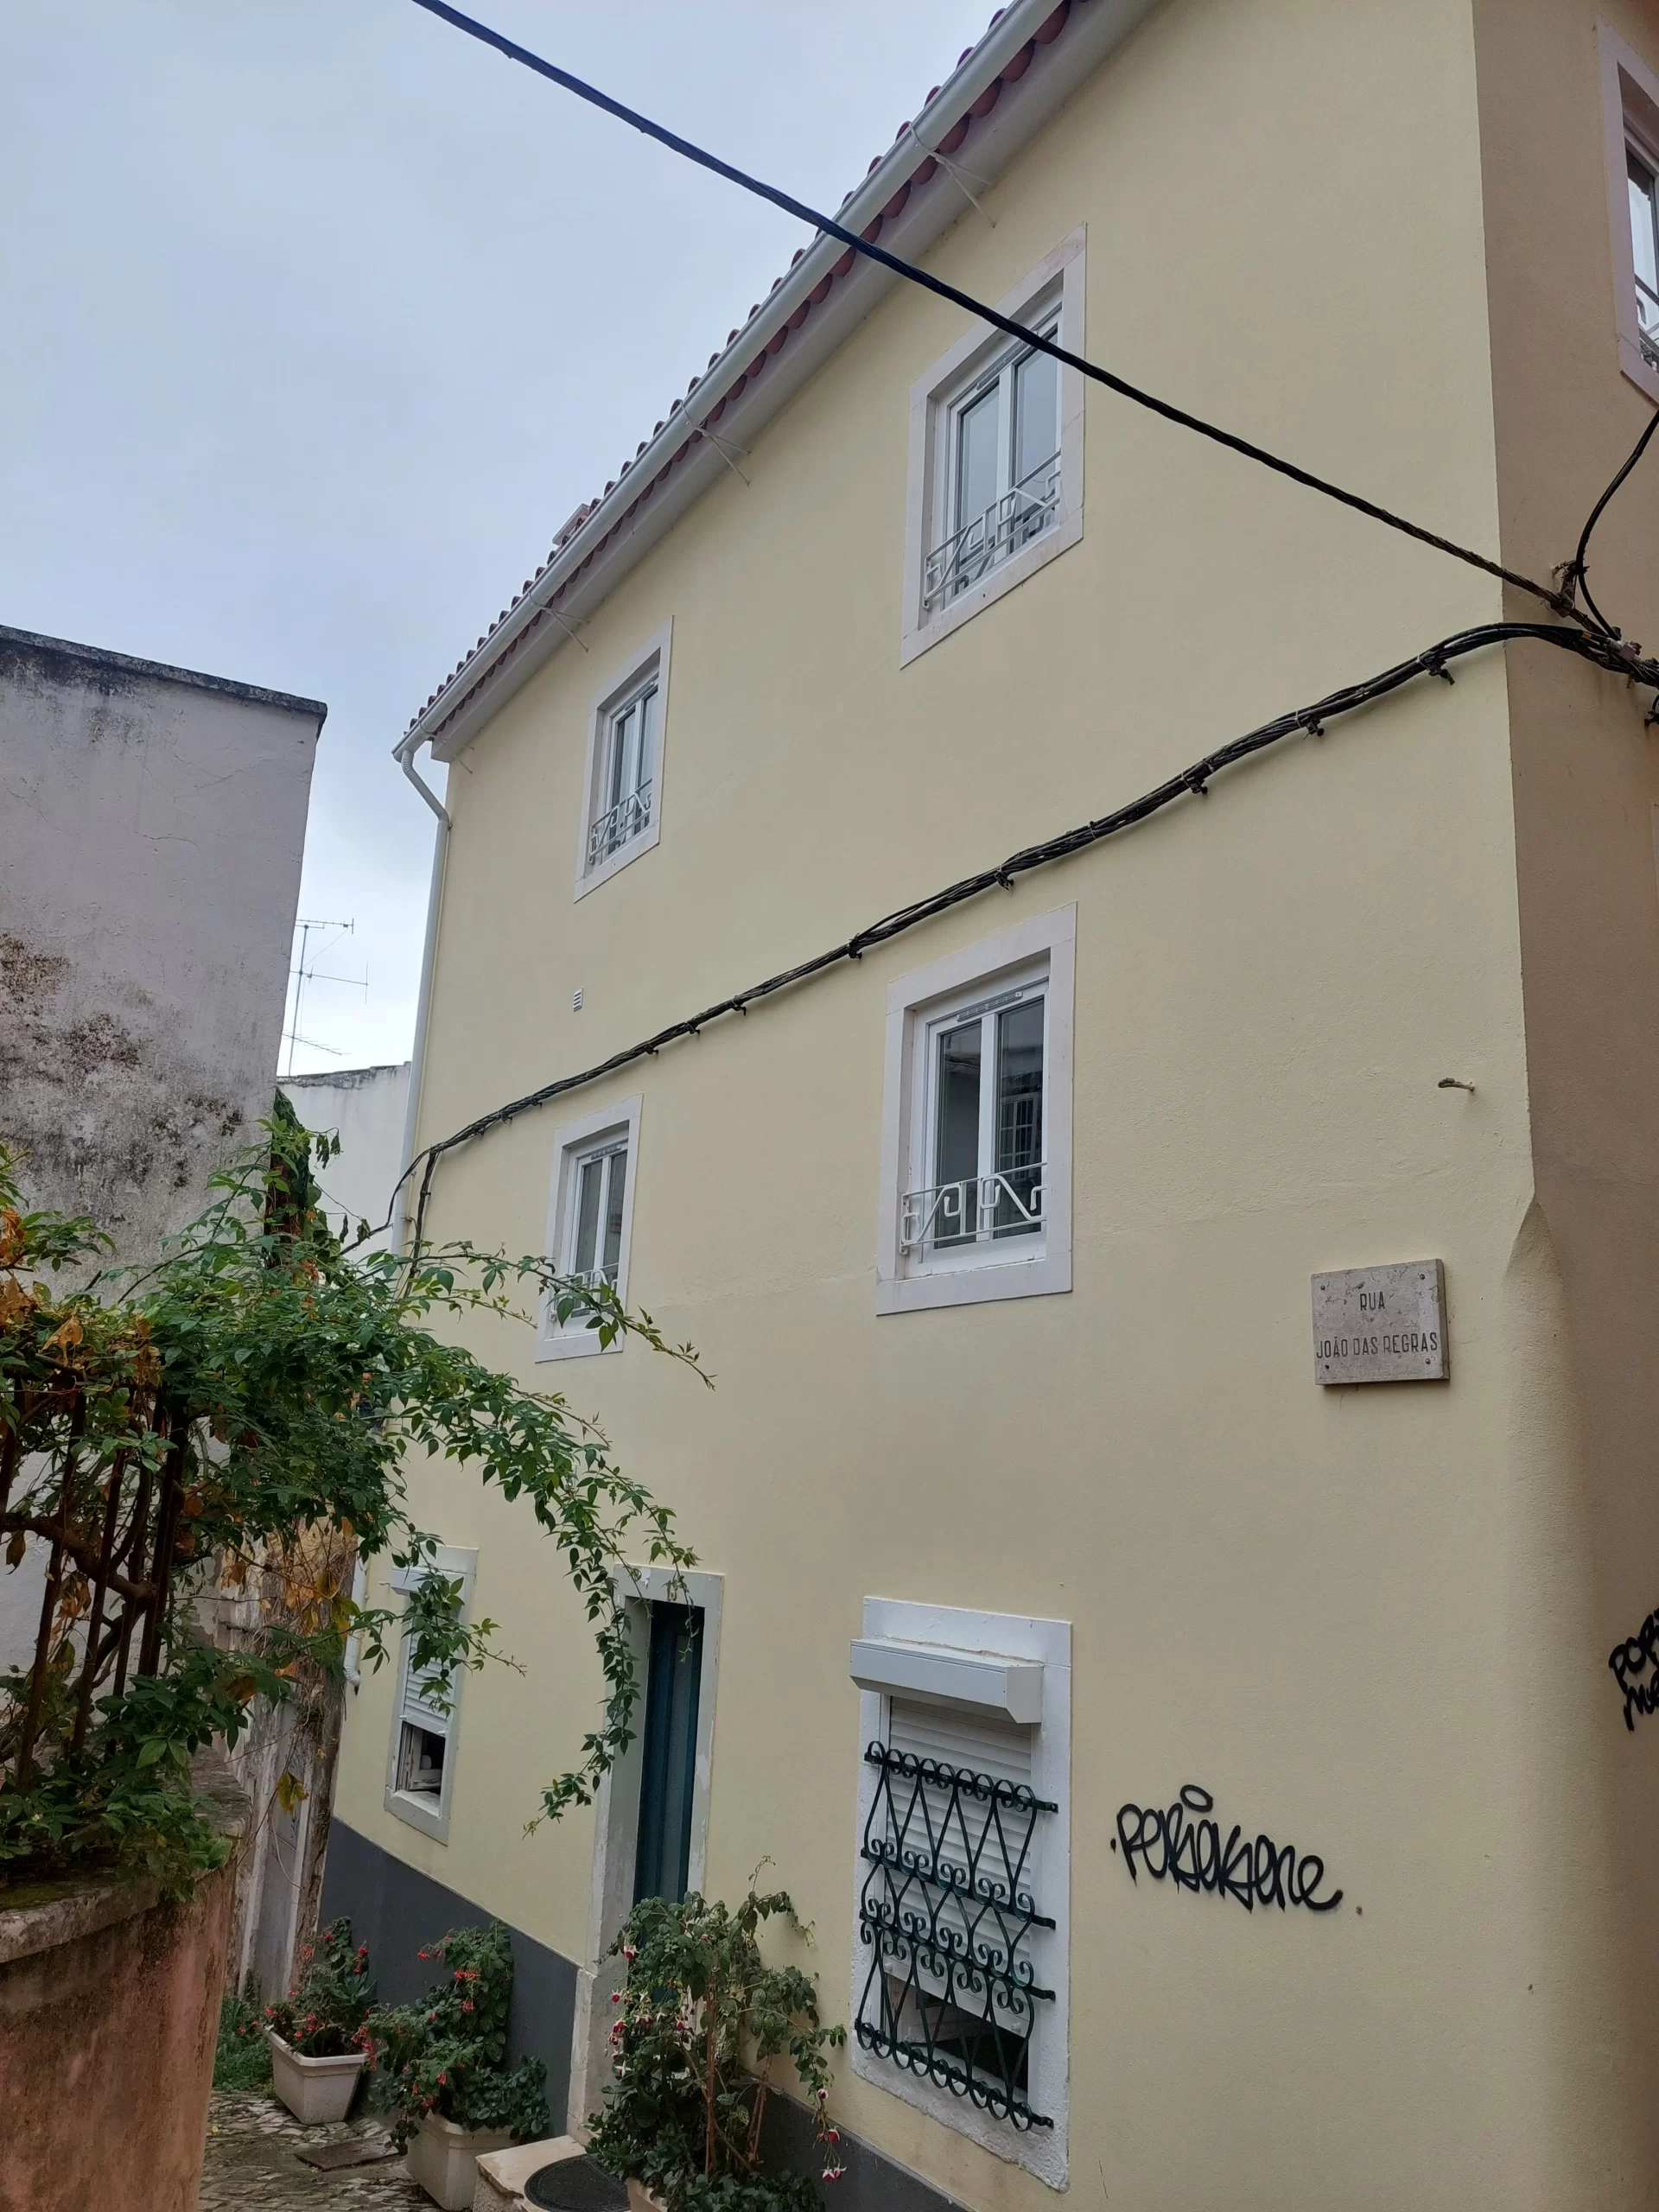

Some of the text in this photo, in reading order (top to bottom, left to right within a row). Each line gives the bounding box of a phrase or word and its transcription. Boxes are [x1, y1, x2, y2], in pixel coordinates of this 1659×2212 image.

[1359, 1291, 1386, 1312] RUA
[1316, 1332, 1438, 1359] JOÃO DAS REGRAS
